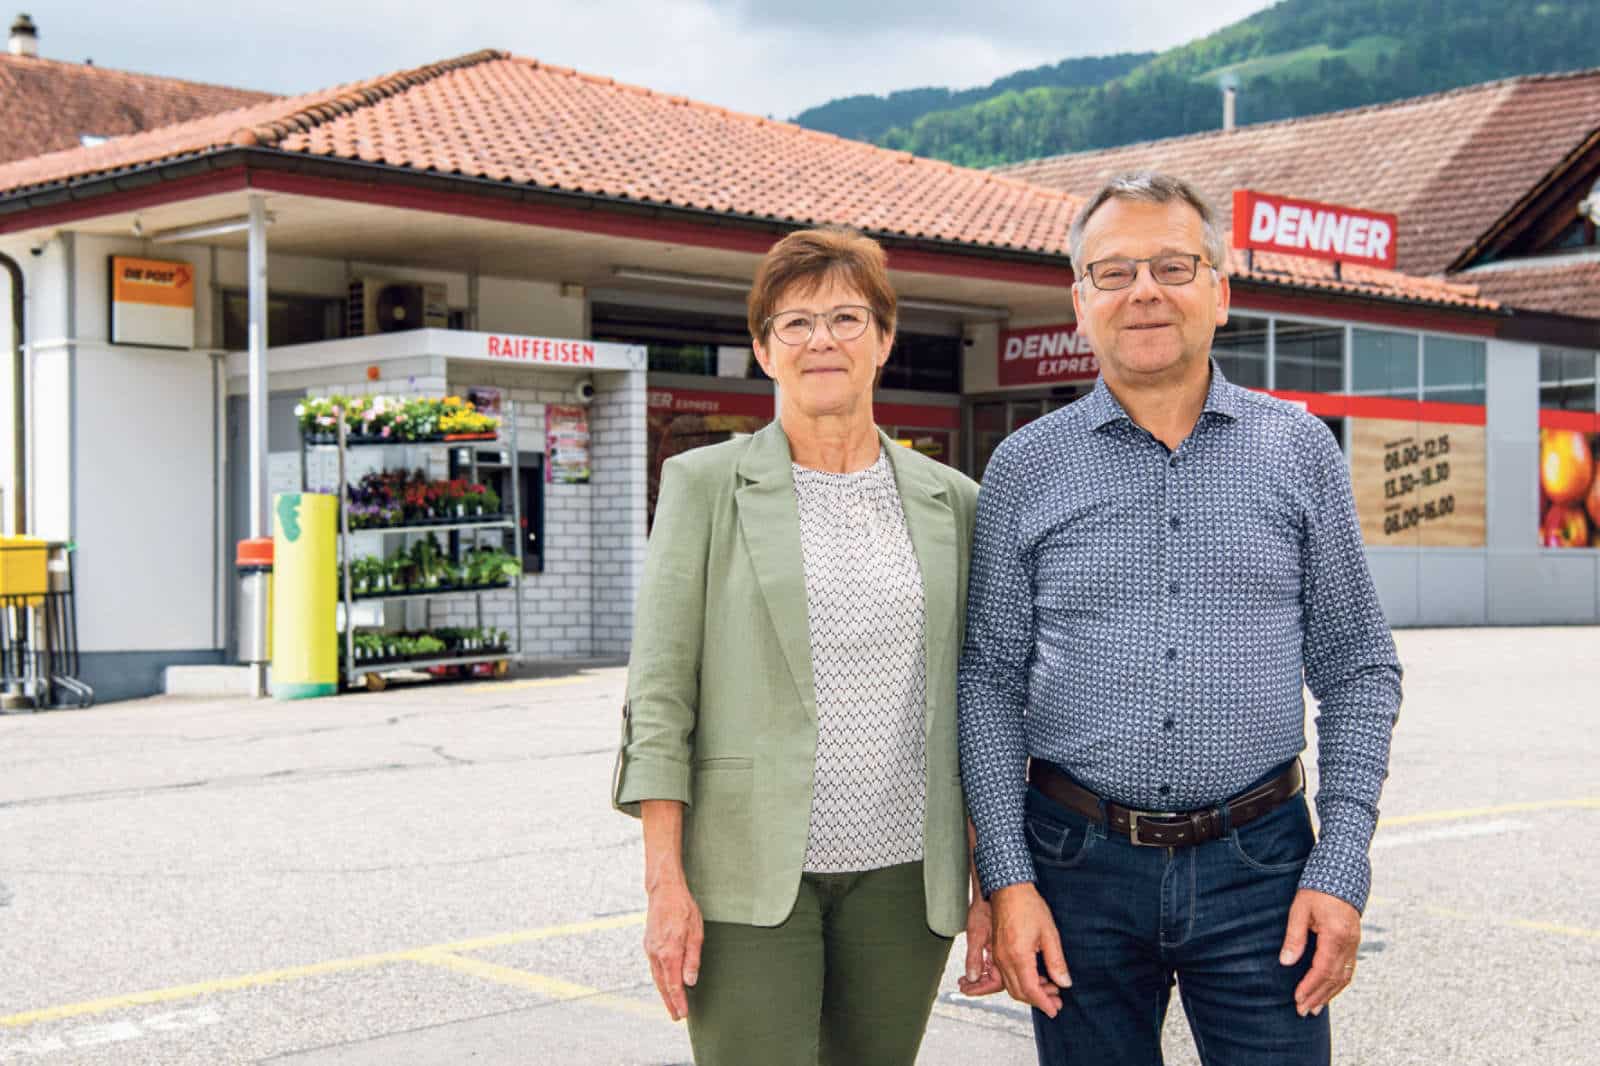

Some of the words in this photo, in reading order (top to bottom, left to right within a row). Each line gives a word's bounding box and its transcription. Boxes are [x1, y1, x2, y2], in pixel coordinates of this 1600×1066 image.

[1249, 201, 1391, 260] DENNER
[124, 267, 142, 280] DIE
[144, 269, 175, 283] POST
[487, 335, 595, 364] RAIFFEISEN
[1004, 332, 1091, 361] DENNE
[1037, 355, 1099, 377] EXPRES
